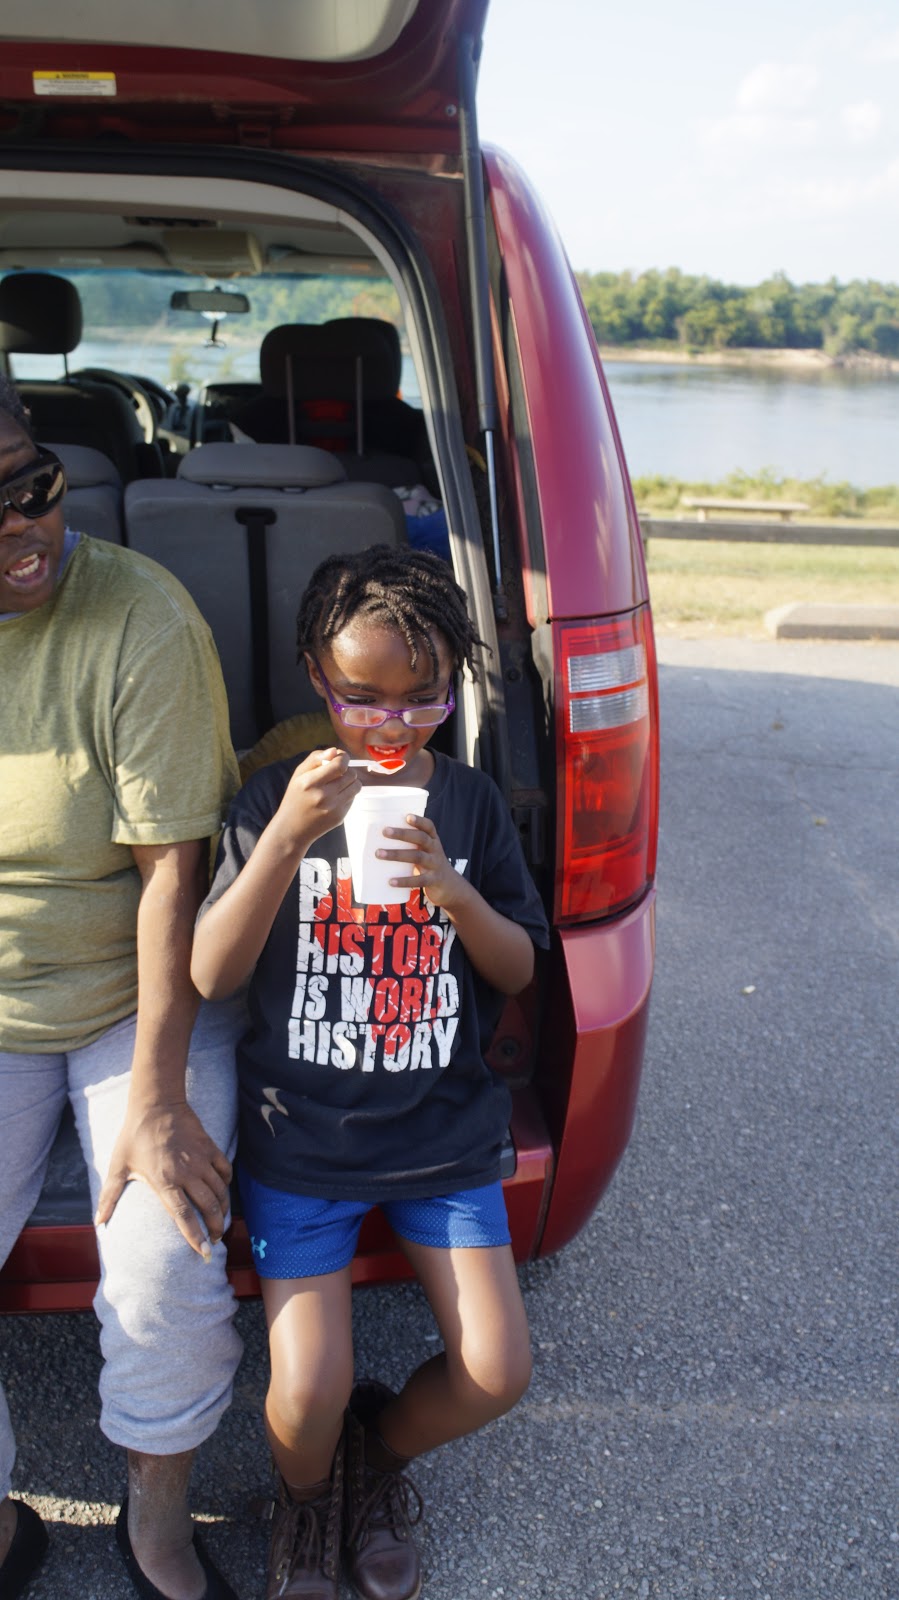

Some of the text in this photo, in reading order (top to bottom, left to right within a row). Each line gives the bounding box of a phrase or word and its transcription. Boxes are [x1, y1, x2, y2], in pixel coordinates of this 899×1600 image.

[296, 923, 457, 976] HISTORY
[291, 973, 460, 1023] IS WORLD
[288, 1017, 460, 1072] HISTORY
